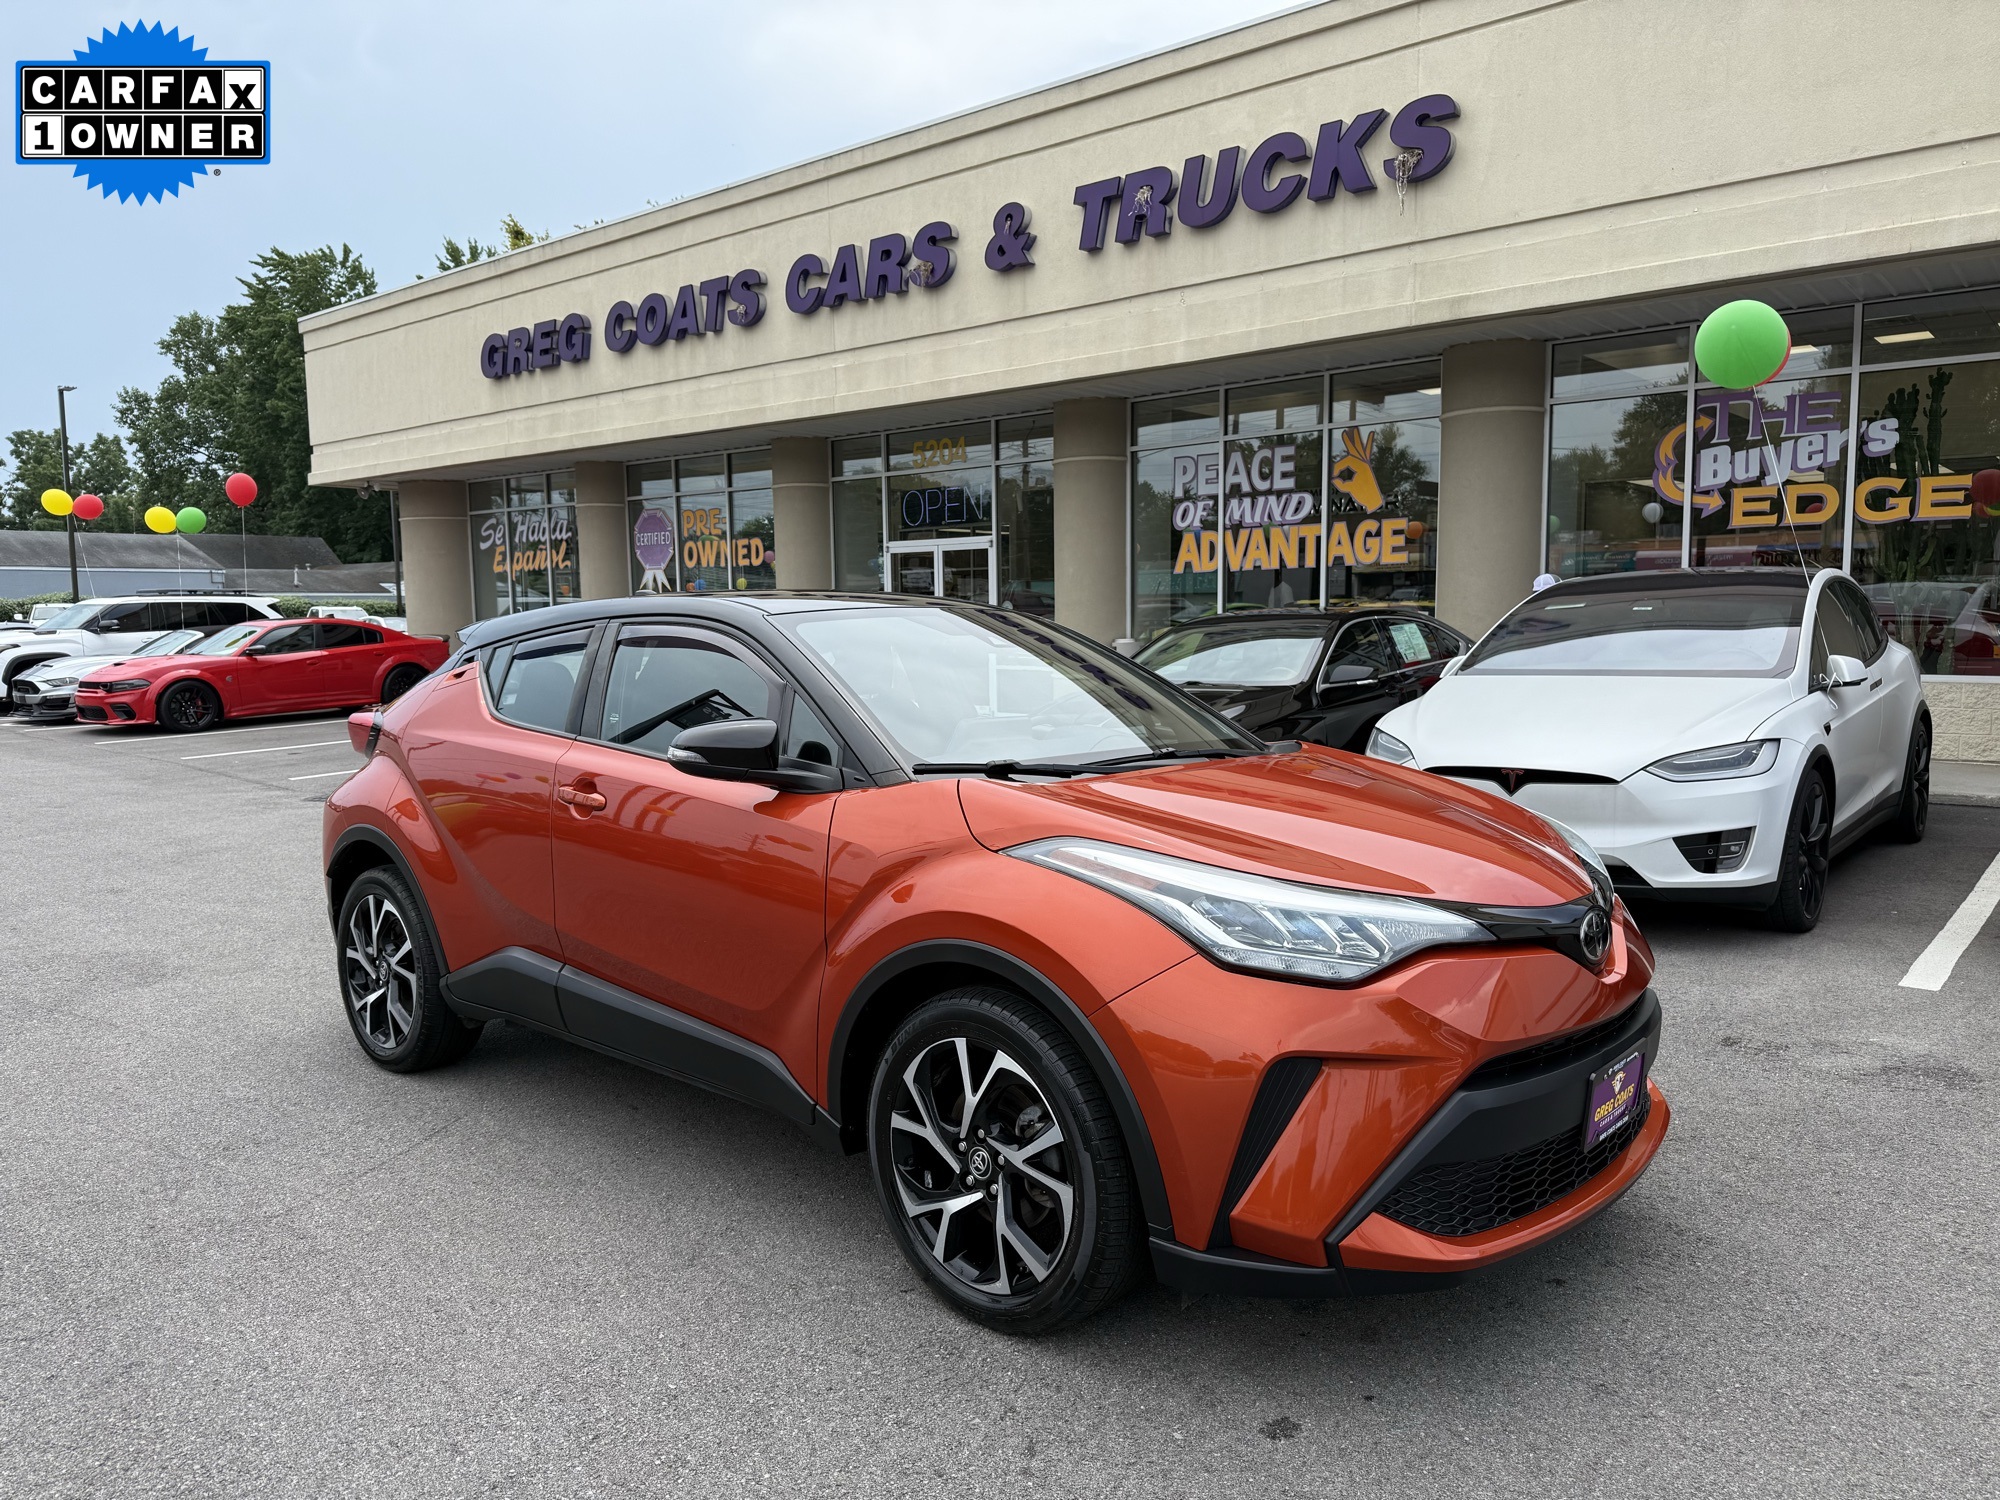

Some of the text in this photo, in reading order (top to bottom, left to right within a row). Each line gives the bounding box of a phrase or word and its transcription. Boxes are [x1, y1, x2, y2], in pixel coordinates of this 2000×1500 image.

[480, 93, 1461, 379] GREG COATS CARS & TRUCKS
[1696, 391, 1842, 444] THE
[913, 436, 967, 469] 5204
[1173, 444, 1297, 499] PEACE
[1694, 417, 1900, 493] Buyer's
[902, 484, 983, 527] OPEN
[1172, 499, 1214, 531] OF
[1224, 491, 1314, 528] MIND
[1727, 472, 1974, 530] EDGE
[480, 509, 573, 550] Se Habla
[635, 530, 671, 547] CERTIFIED
[1173, 517, 1410, 575] ADVANTAGE
[493, 541, 572, 581] Epañl
[683, 537, 764, 569] OWNED
[1594, 1083, 1635, 1122] GREG COATS
